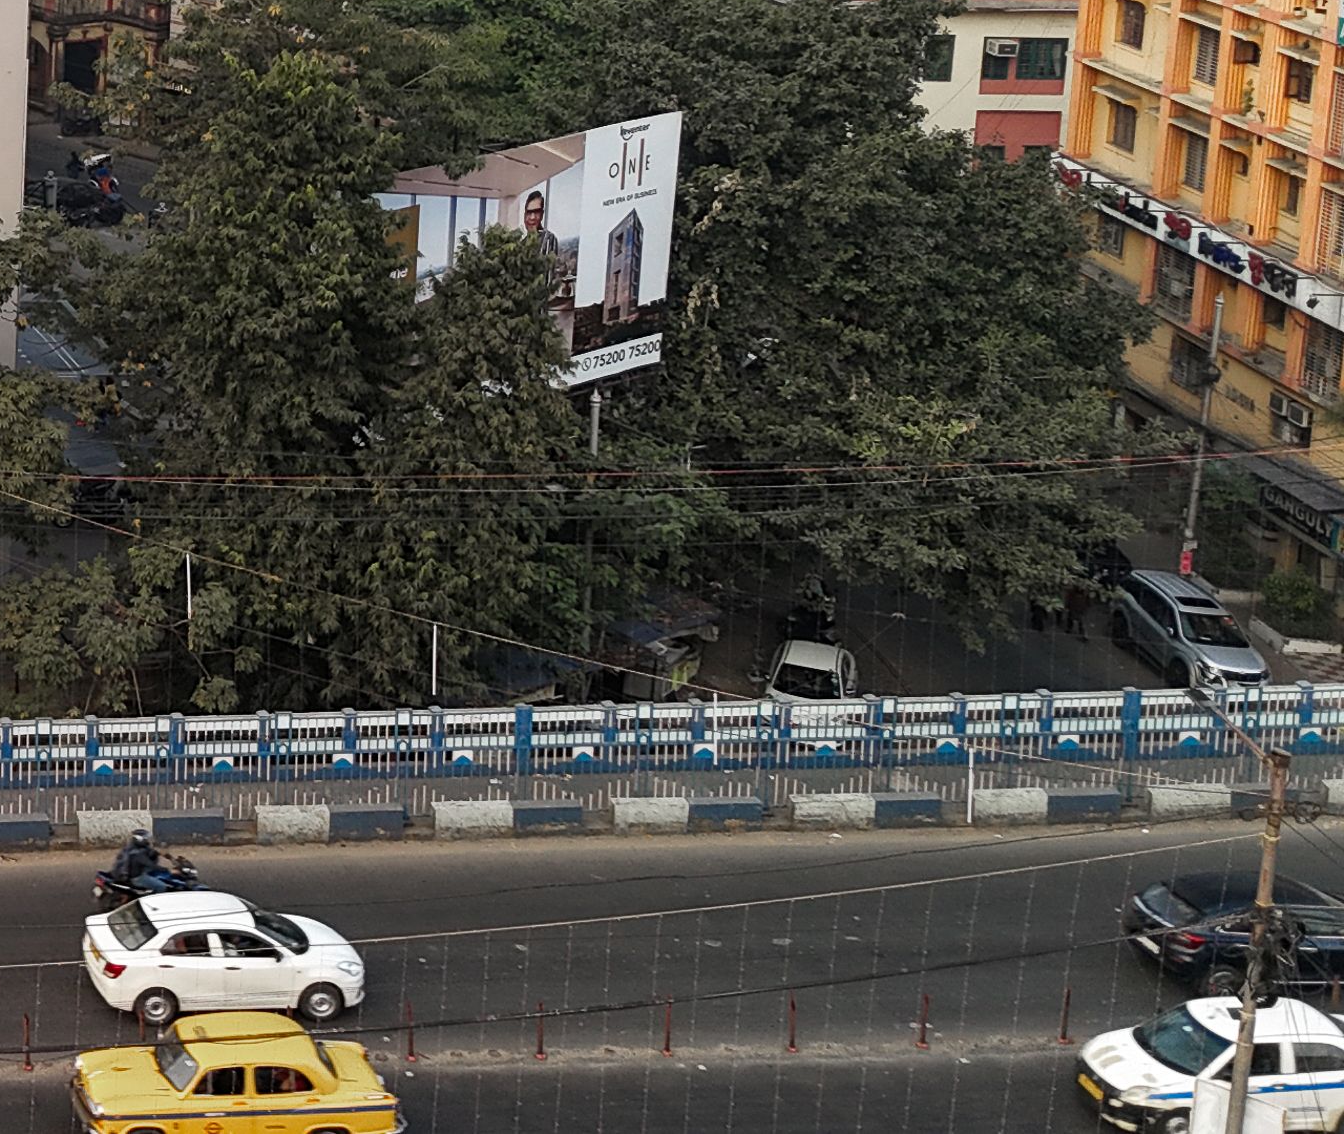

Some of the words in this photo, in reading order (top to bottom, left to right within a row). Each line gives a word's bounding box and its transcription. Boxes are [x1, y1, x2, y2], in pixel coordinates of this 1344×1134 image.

[593, 349, 626, 369] 75200
[628, 339, 661, 359] 75200
[1263, 485, 1332, 538] GANGULY
